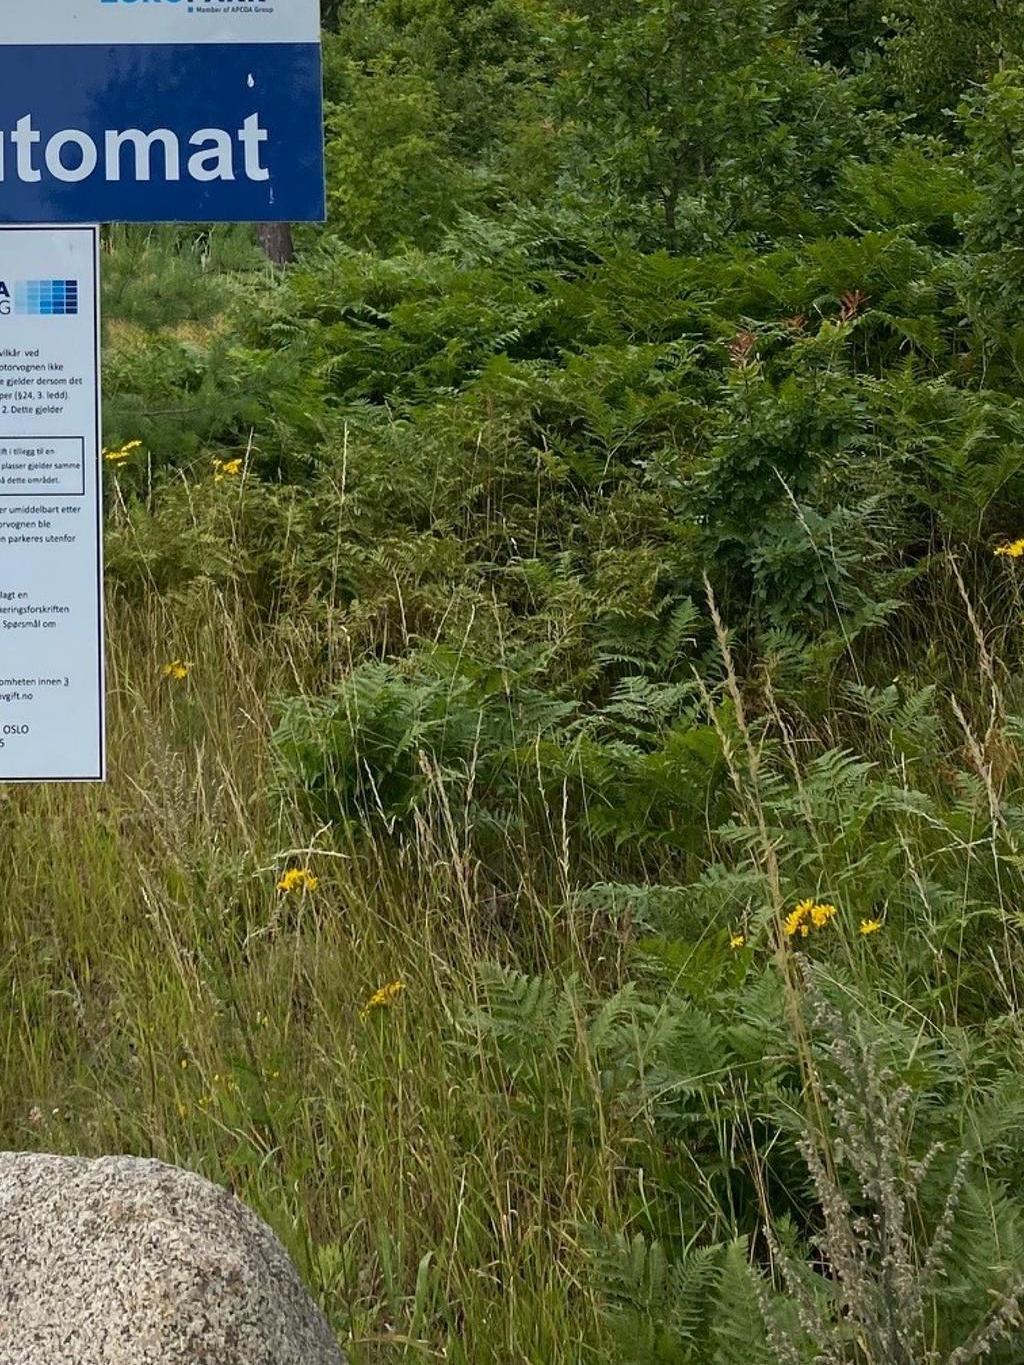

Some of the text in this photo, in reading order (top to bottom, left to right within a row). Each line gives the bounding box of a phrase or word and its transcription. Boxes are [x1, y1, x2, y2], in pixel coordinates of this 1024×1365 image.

[47, 363, 63, 371] ikke
[37, 521, 51, 529] ble
[7, 535, 43, 545] parkeres
[44, 535, 75, 543] utenfor
[37, 678, 62, 686] innen
[2, 724, 29, 733] OSLO
